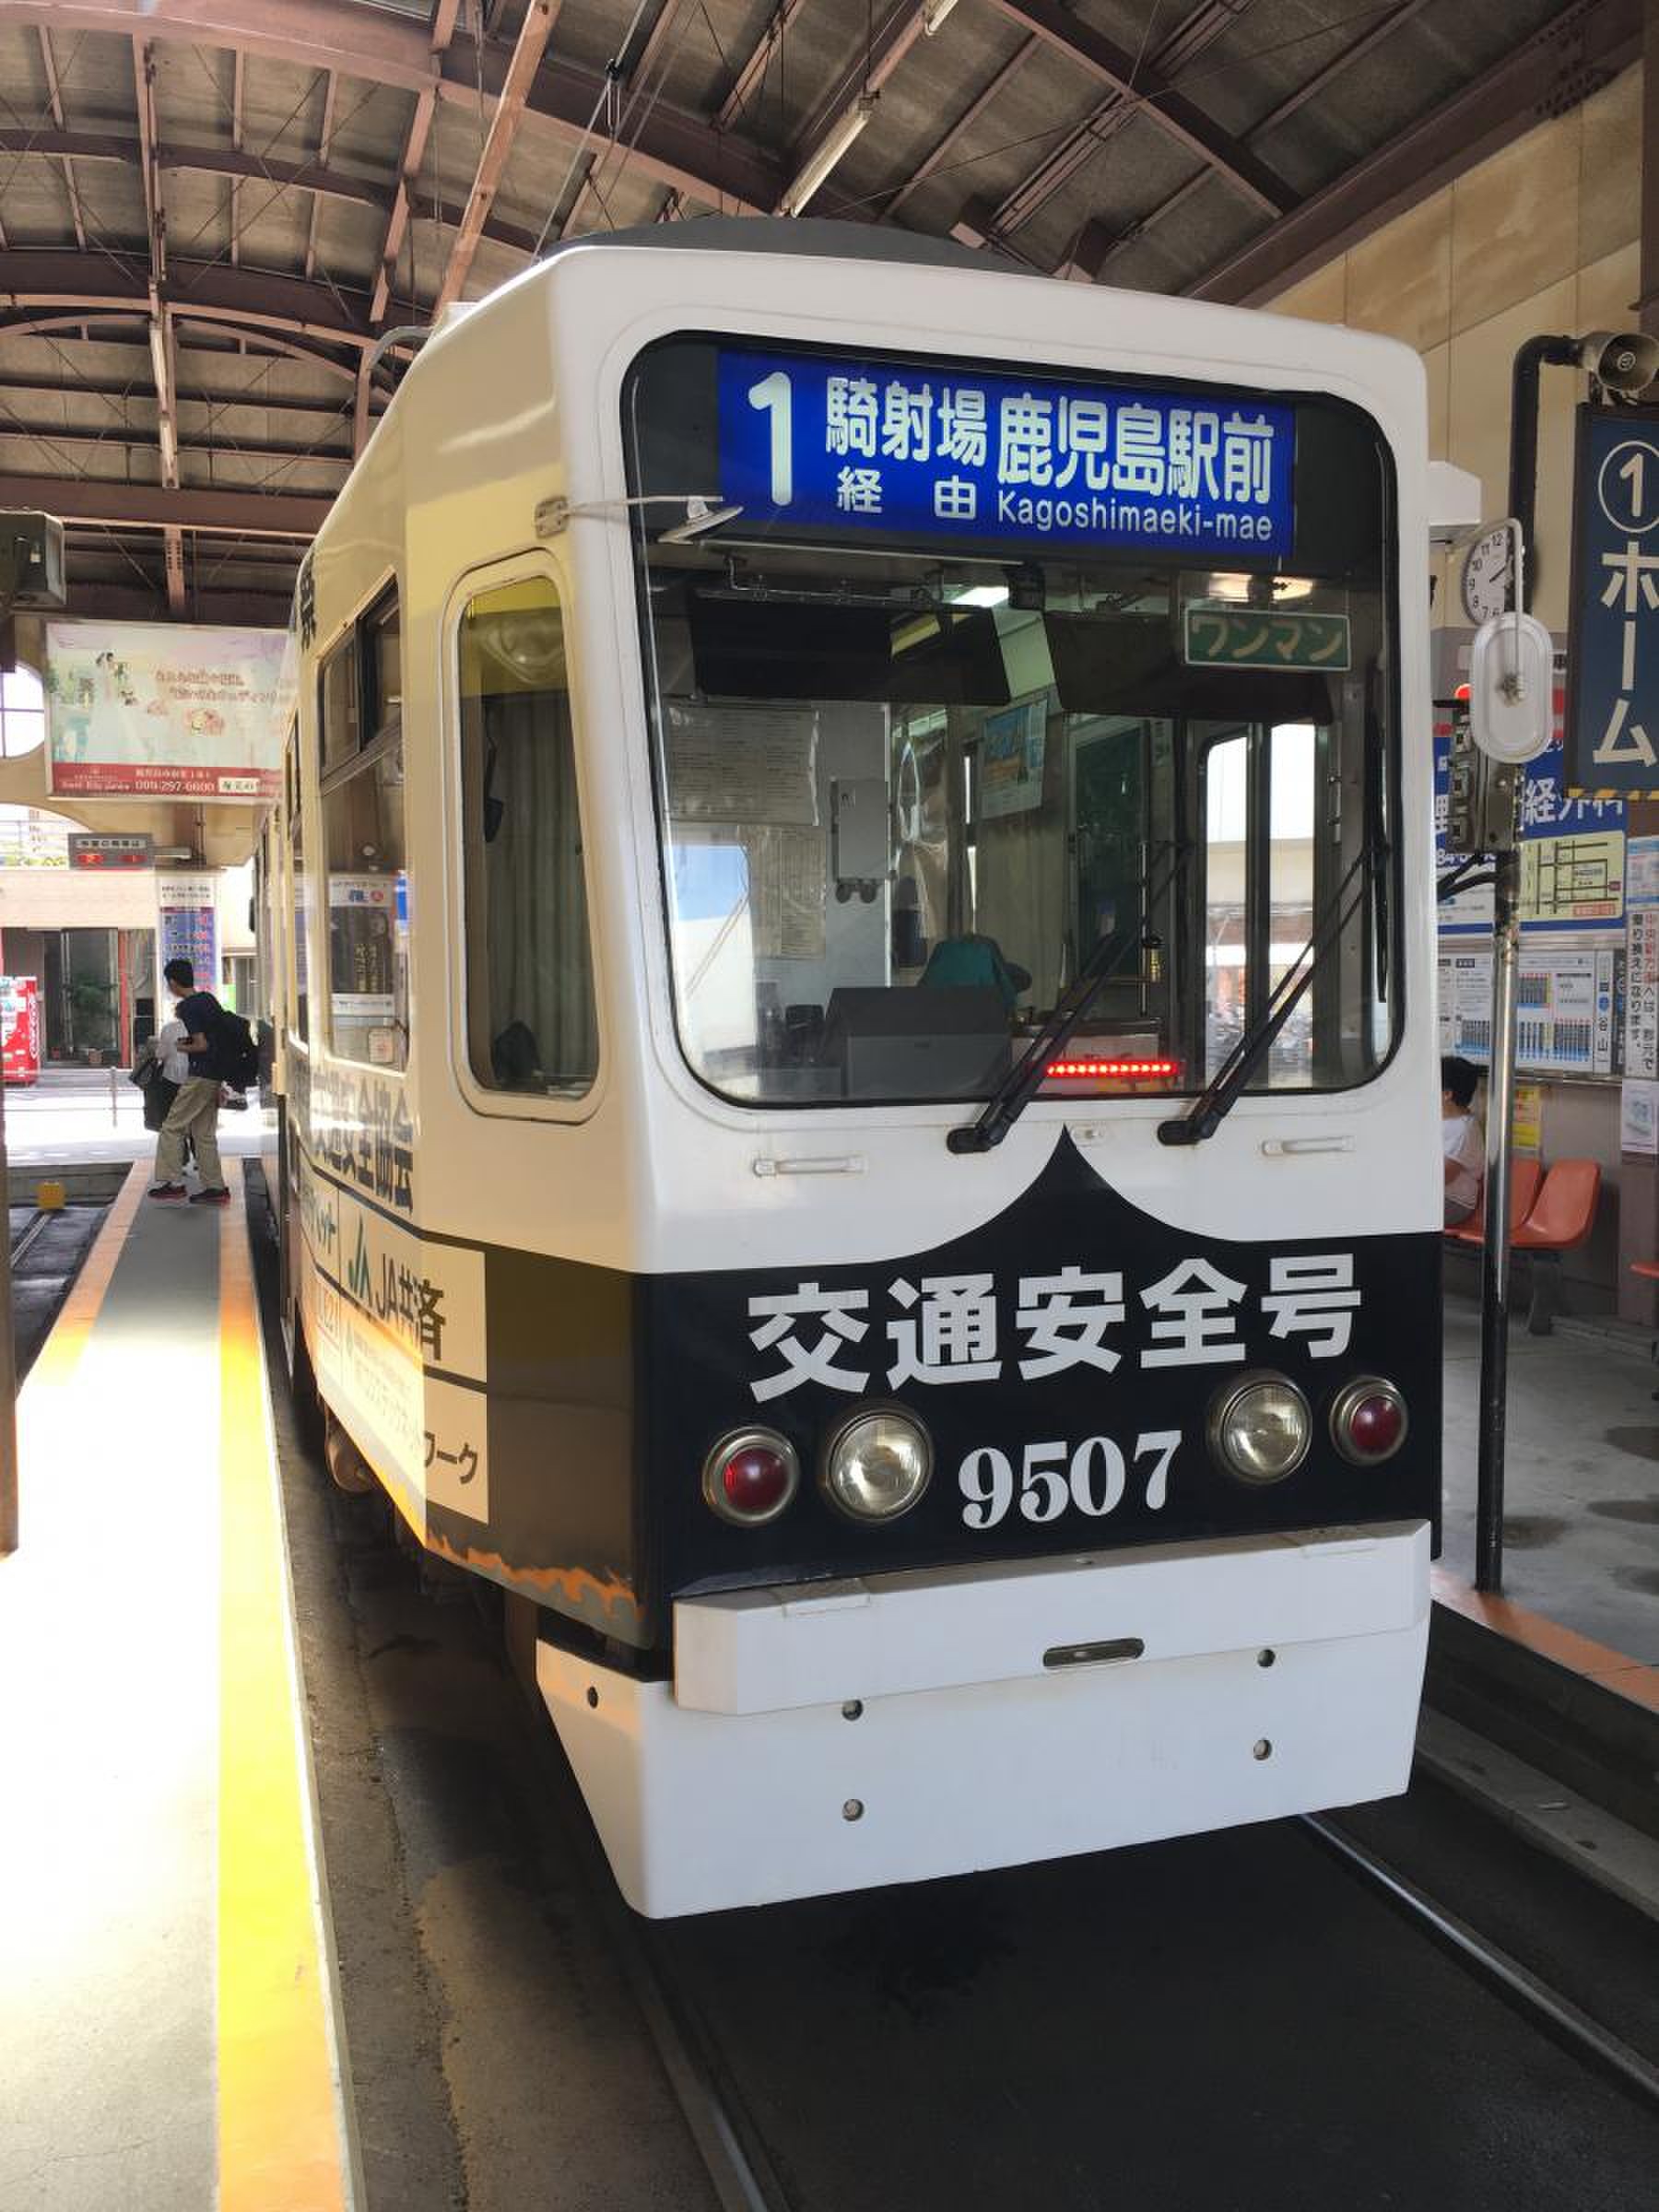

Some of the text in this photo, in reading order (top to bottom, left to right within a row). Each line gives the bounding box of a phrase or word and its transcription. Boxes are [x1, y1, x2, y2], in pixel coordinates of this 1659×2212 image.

[747, 371, 793, 506] 1
[826, 376, 986, 466] 騎射場
[997, 392, 1274, 504] 鹿児島駅前
[997, 498, 1272, 541] Kagoshimaeki-mae
[1192, 616, 1343, 663] ワンマン
[748, 1253, 1361, 1403] 交通安全号
[959, 1430, 1182, 1529] 9507
